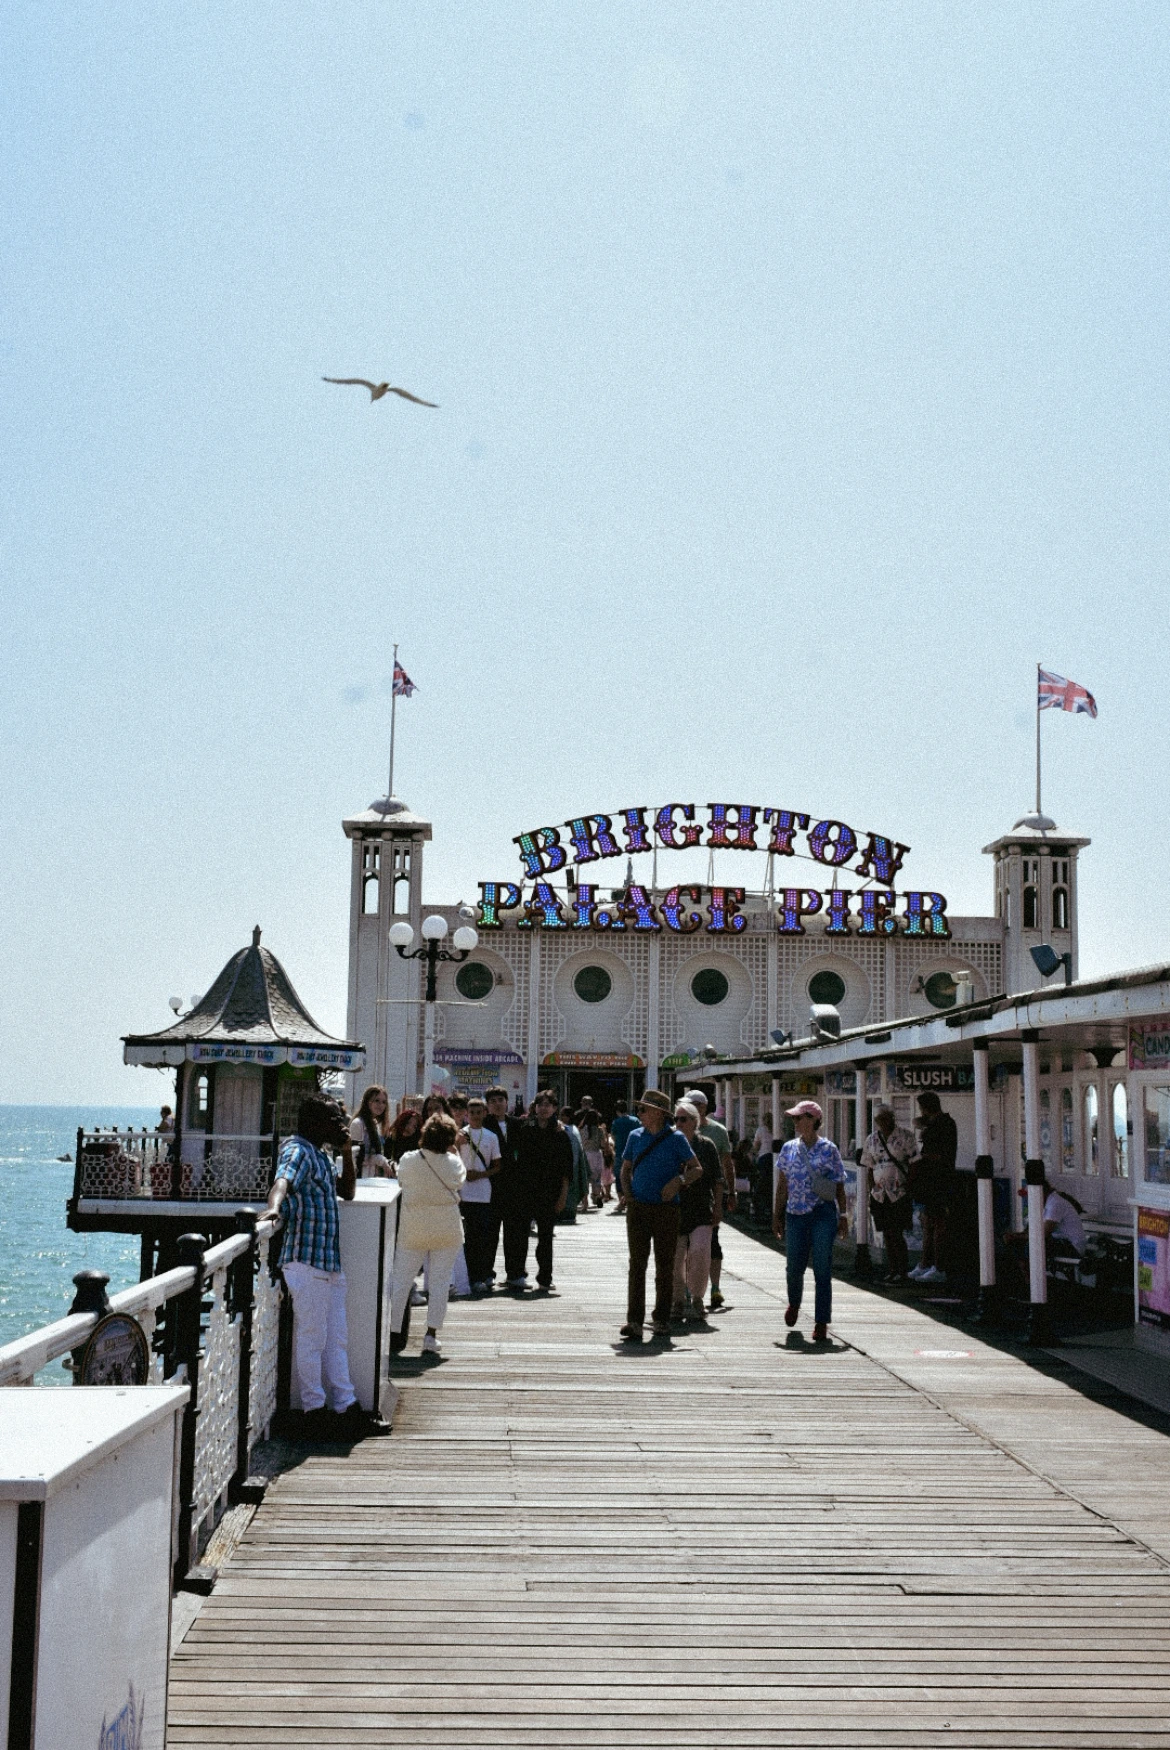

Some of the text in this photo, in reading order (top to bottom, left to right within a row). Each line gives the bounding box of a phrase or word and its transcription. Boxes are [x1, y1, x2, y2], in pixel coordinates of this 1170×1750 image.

[513, 803, 911, 886] BRIGHTON
[477, 881, 952, 939] PALACE PIER
[444, 1054, 472, 1062] MACHINE
[494, 1055, 519, 1063] ARCADE
[667, 1057, 683, 1065] THE
[903, 1071, 975, 1086] SLUSH BA
[762, 1082, 796, 1094] COFEE
[1139, 1215, 1169, 1233] BRIGHTON
